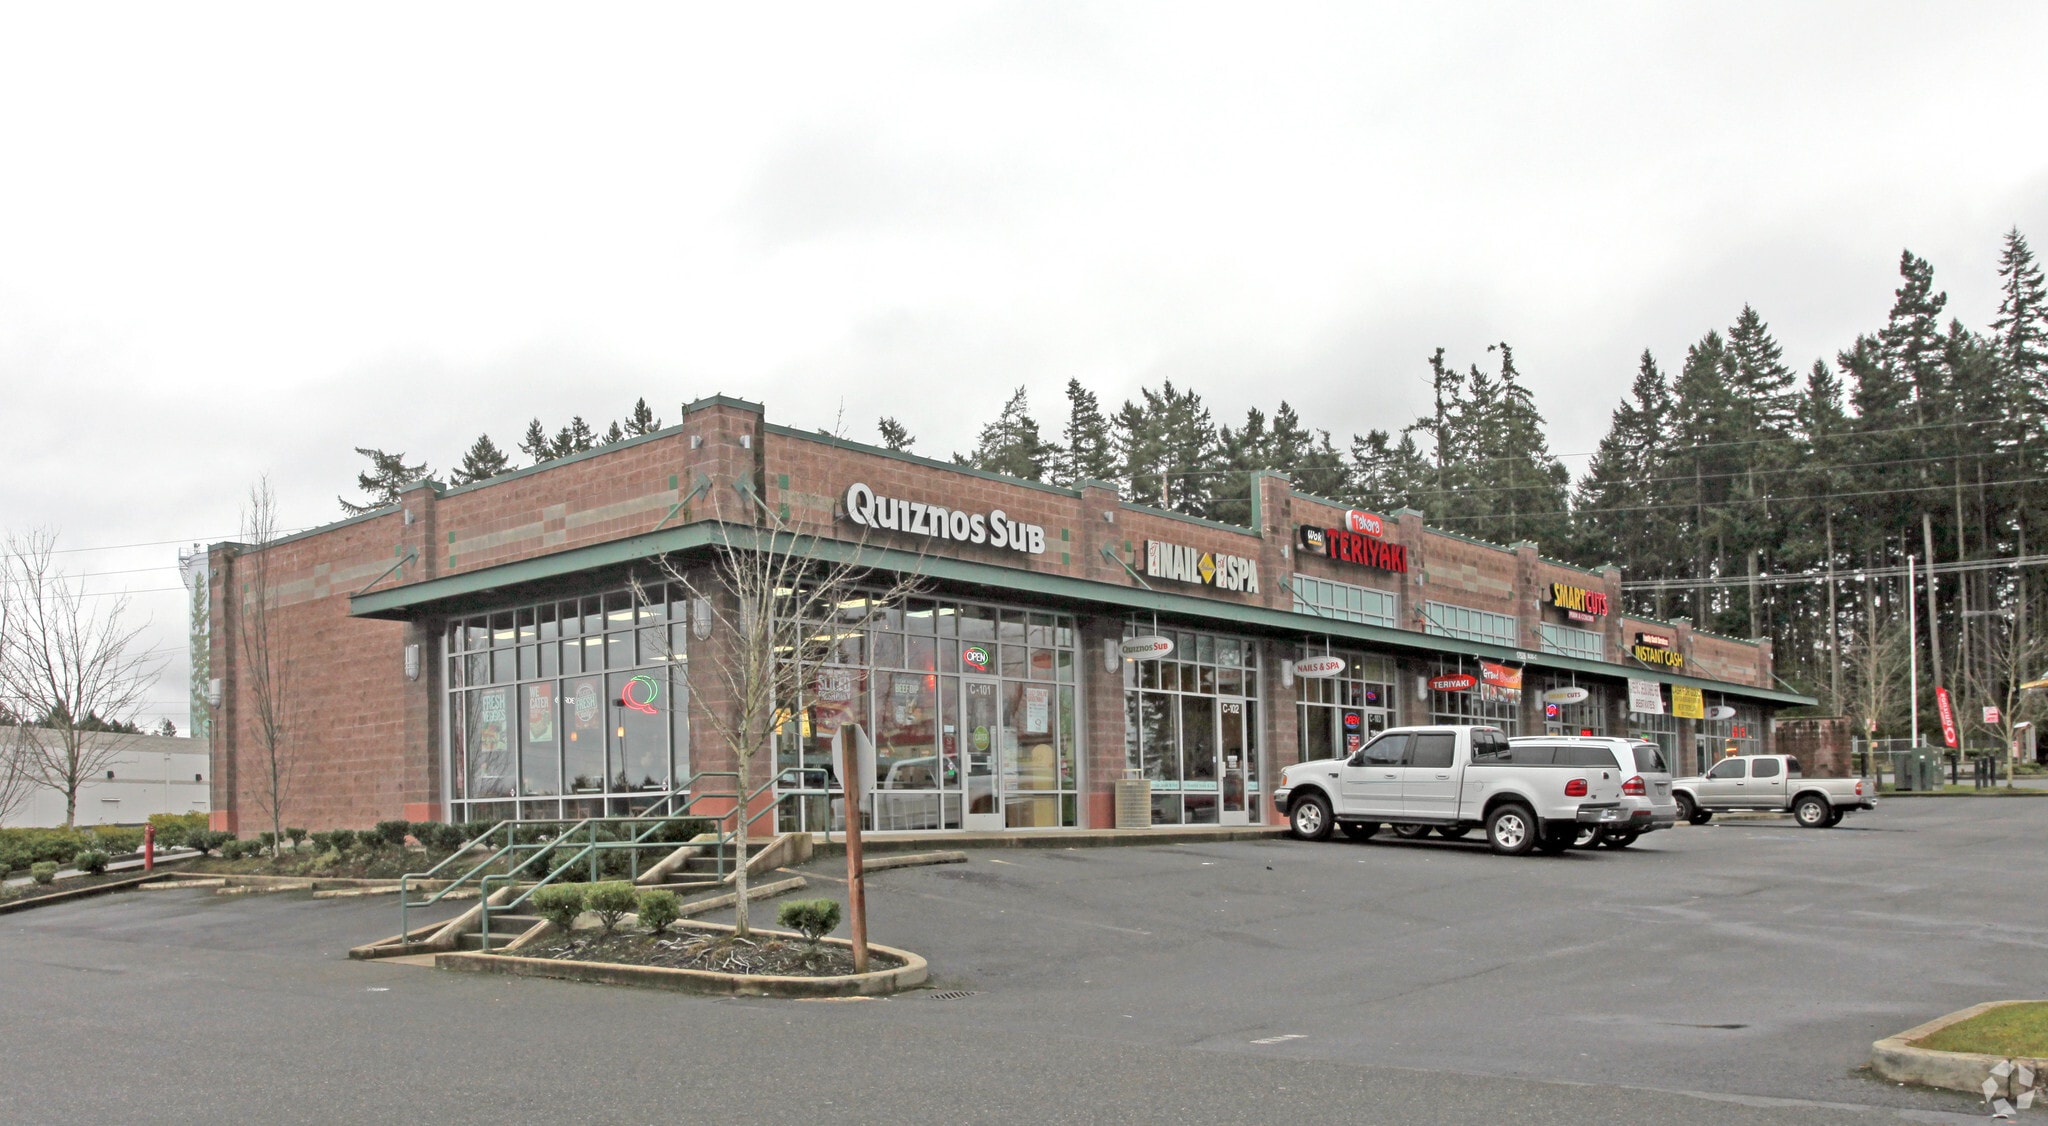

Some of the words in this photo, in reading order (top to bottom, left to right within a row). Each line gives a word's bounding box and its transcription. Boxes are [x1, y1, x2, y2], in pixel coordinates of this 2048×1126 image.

[1353, 514, 1380, 534] Takara
[1308, 530, 1322, 542] Wok
[1326, 528, 1407, 573] TERIYAKI
[1160, 541, 1202, 584] NAIL
[1227, 554, 1259, 593] SPA
[966, 651, 985, 662] OPEN
[1635, 646, 1664, 665] INSTANT
[1665, 650, 1683, 667] CASH
[1297, 664, 1318, 672] NAILS
[1319, 663, 1324, 671] &
[1326, 662, 1339, 670] SPA
[970, 684, 991, 695] C-101
[1434, 679, 1469, 688] TERIYAKI
[482, 693, 505, 711] FRESH
[530, 697, 549, 709] CATER
[1222, 703, 1240, 714] C-102
